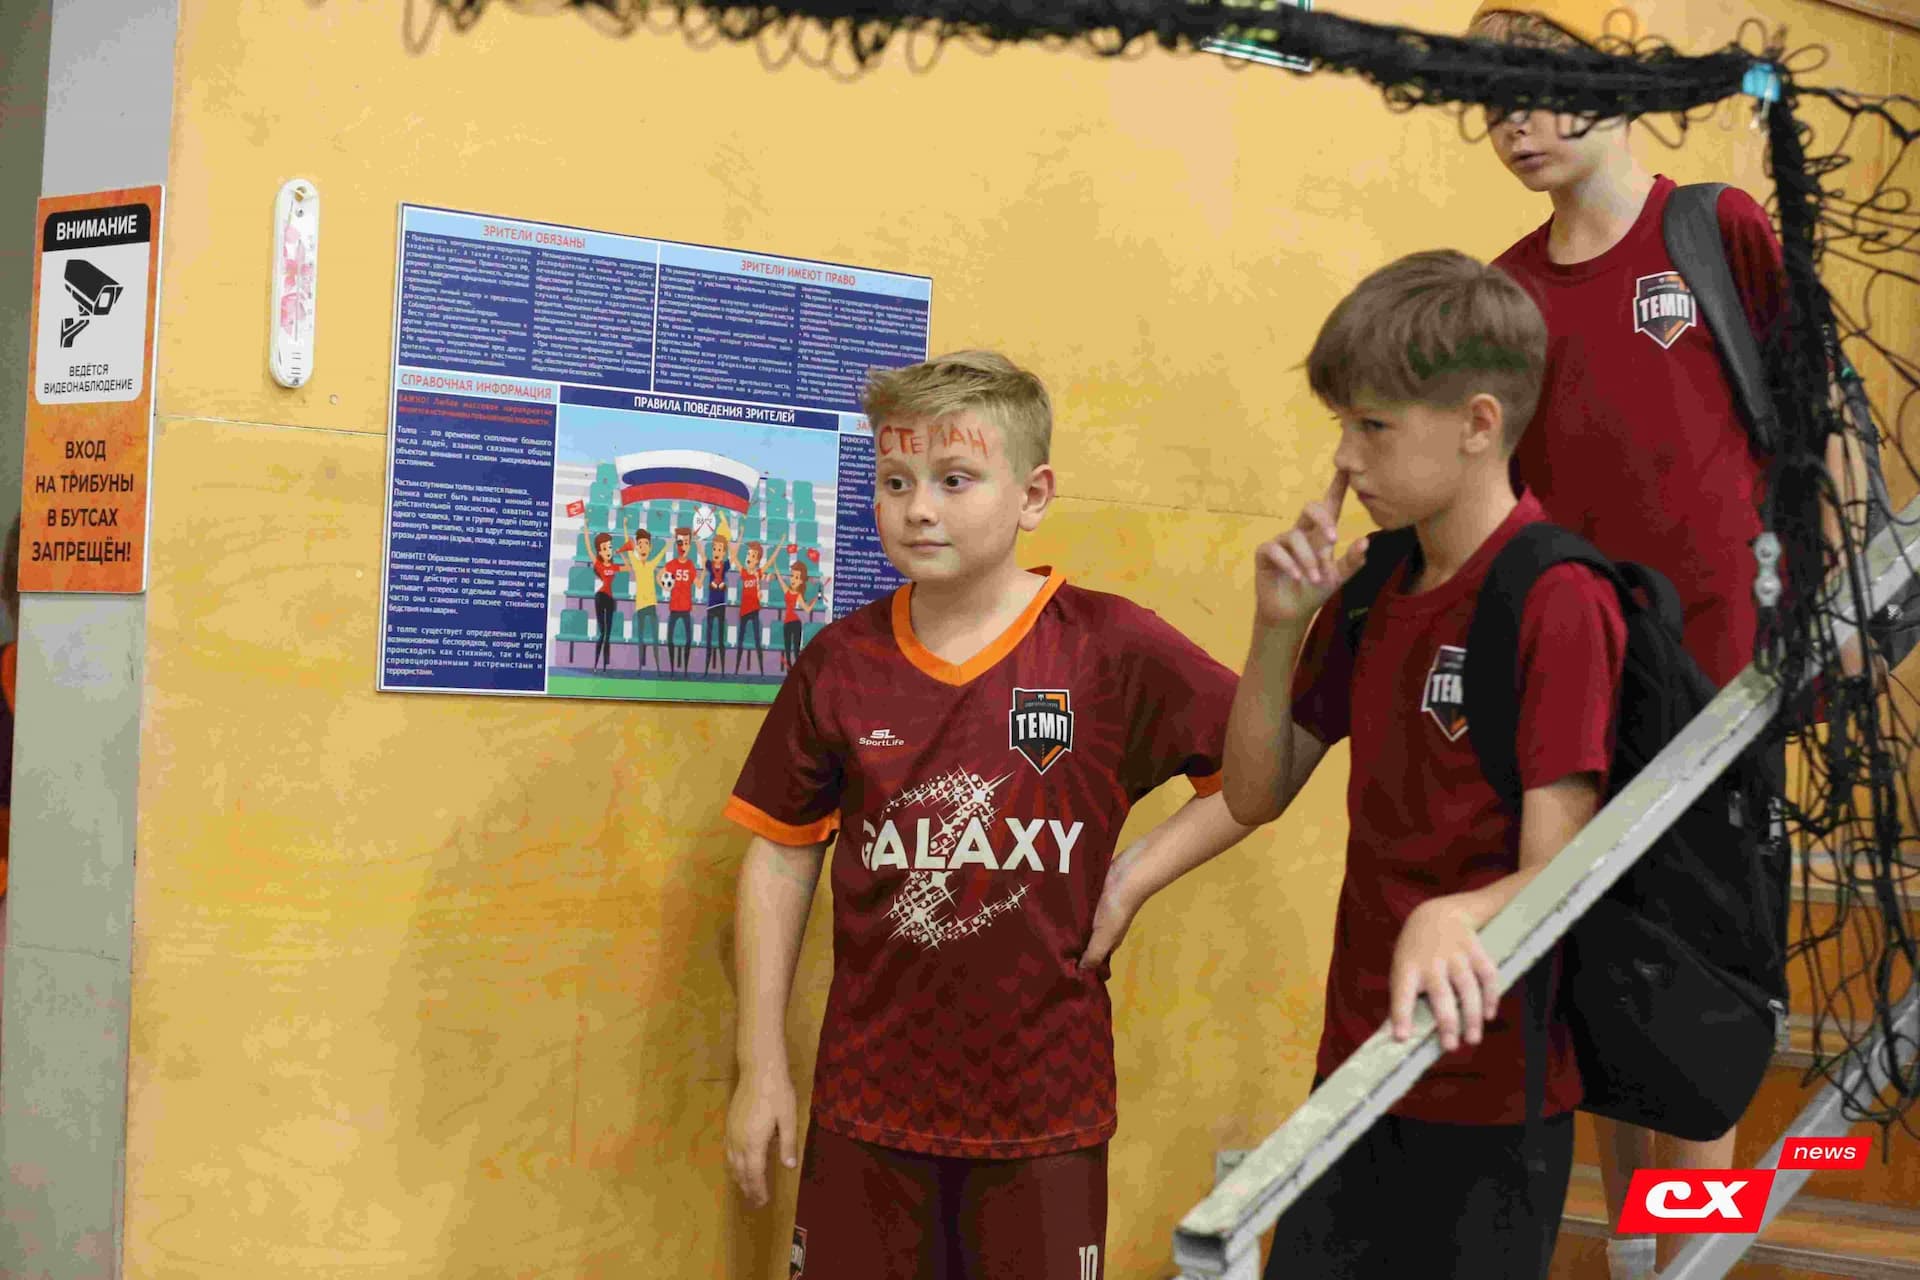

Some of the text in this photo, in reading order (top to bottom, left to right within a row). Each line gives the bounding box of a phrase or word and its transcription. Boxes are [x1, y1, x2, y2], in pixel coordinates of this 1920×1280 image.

[56, 214, 138, 240] ВНИМАНИЕ
[483, 225, 532, 240] ЗРИТЕЛИ
[536, 232, 586, 248] ОБЯЗАНЫ
[741, 260, 856, 286] ЗРИТЕЛИ ИМЕЮТ ПРАВО
[1639, 293, 1690, 322] ТЕМП
[70, 363, 108, 377] ВЕДЁТСЯ
[44, 379, 133, 394] ВИДЕОНАБЛЮДЕНИЕ
[402, 374, 552, 400] СПРАВОЧНАЯ ИНФОРМАЦИЯ
[634, 396, 794, 423] ПРАВИЛА ПОВЕДЕНИЯ ЗРИТЕЛЕЙ
[397, 425, 416, 434] Толпа
[444, 431, 480, 440] временное
[483, 434, 517, 443] скопление
[520, 436, 552, 446] большого
[66, 440, 106, 462] ВХОД
[395, 446, 427, 456] объектом
[430, 450, 462, 459] внимания
[422, 438, 448, 448] людей,
[452, 442, 482, 450] взаимно
[486, 445, 523, 454] связанных
[527, 447, 551, 457] общим
[36, 474, 134, 493] НА ТРИБУНЫ
[394, 477, 418, 486] Частым
[419, 480, 453, 490] спутником
[393, 488, 420, 497] Паника
[450, 492, 468, 501] быть
[504, 496, 532, 505] мнимой
[392, 498, 451, 510] действительной
[454, 504, 498, 513] опасностью,
[501, 508, 532, 516] охватить
[48, 508, 118, 527] В БУТСАХ
[392, 510, 415, 518] одного
[472, 516, 494, 524] группу
[495, 516, 516, 526] людей
[518, 519, 542, 527] (толпу)
[392, 520, 429, 530] возникнуть
[485, 527, 502, 535] вдруг
[391, 531, 414, 540] угрозы
[32, 536, 131, 565] ЗАПРЕЩЁН!
[391, 550, 425, 560] ПОМНИТЕ!
[427, 552, 469, 563] Образование
[415, 564, 433, 572] могут
[676, 569, 689, 582] 55
[422, 573, 457, 584] действует
[389, 584, 423, 592] учитывает
[426, 586, 458, 594] интересы
[461, 588, 496, 596] отдельных
[388, 604, 418, 613] бедствия
[504, 599, 544, 608] стихийного
[420, 627, 462, 636] существует
[466, 629, 516, 638] определенная
[442, 637, 488, 647] беспорядков,
[492, 640, 520, 649] которые
[386, 646, 436, 655] происходить
[524, 651, 542, 659] быть
[386, 657, 468, 667] спровоцированными
[473, 660, 533, 669] экстремистами
[1016, 712, 1068, 742] ТЕМП
[858, 737, 904, 746] SportLife
